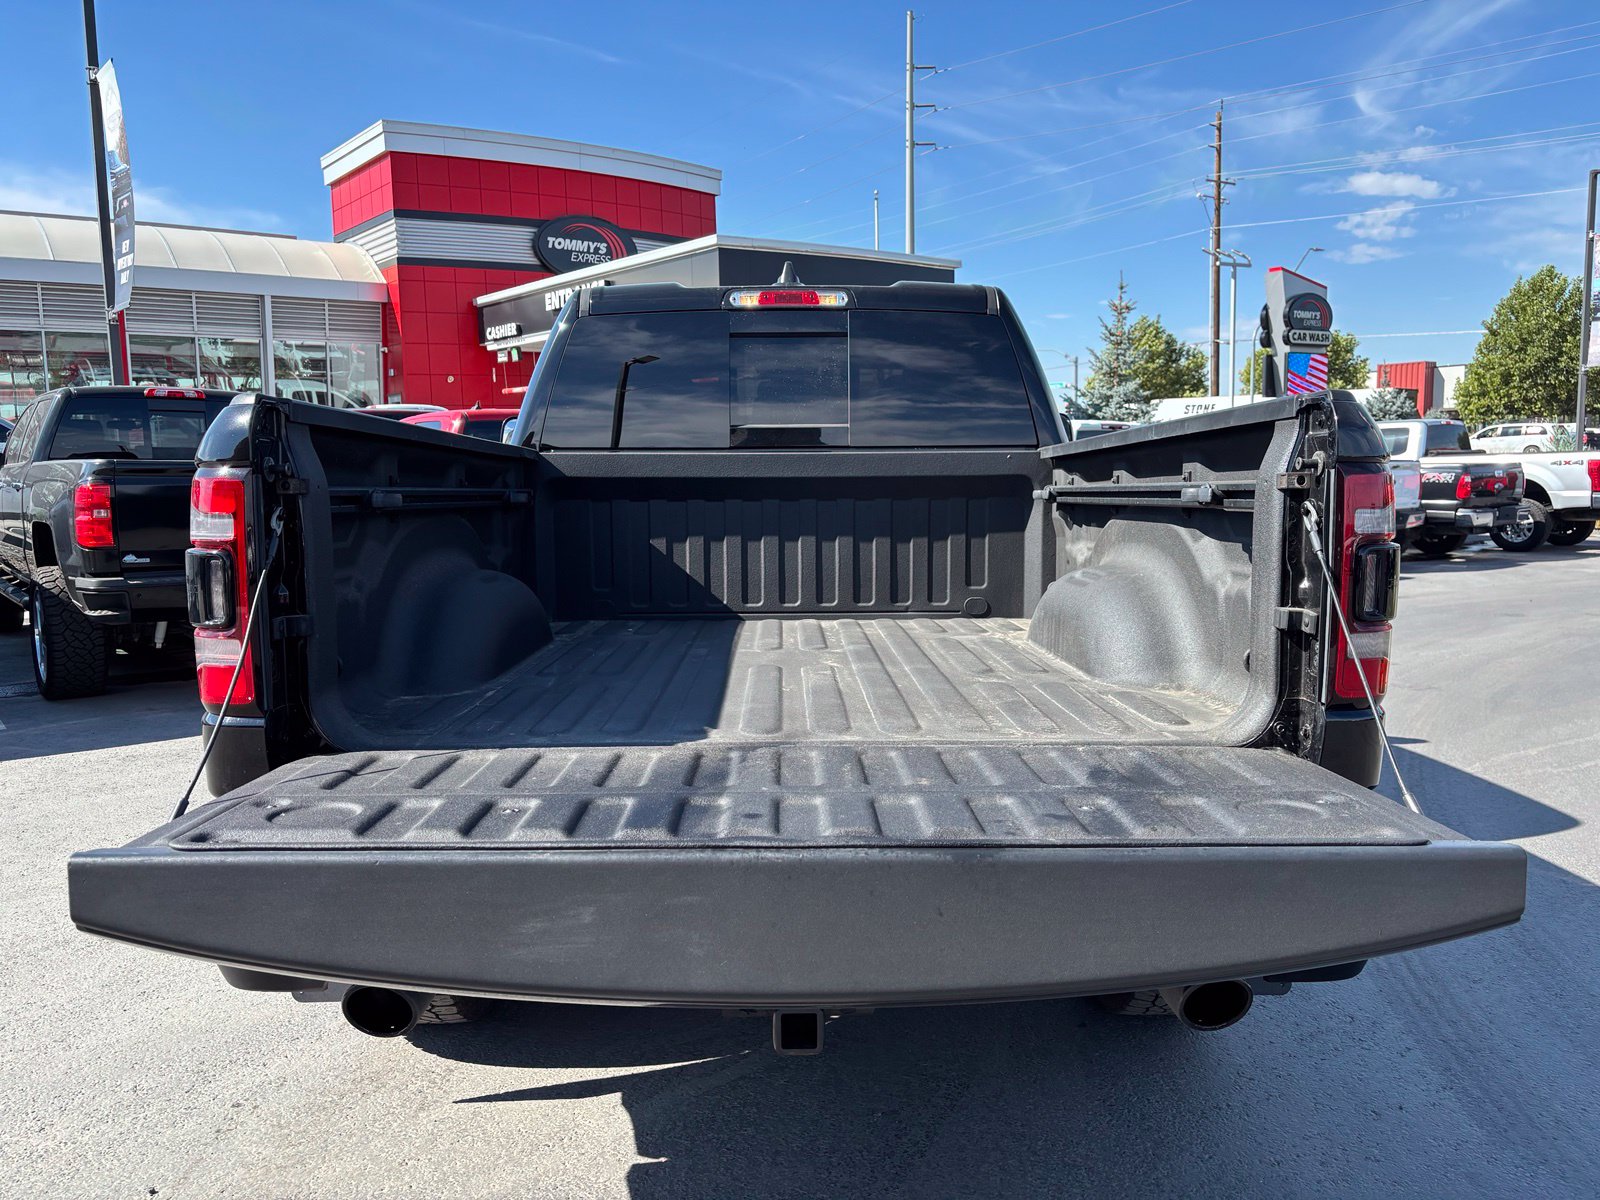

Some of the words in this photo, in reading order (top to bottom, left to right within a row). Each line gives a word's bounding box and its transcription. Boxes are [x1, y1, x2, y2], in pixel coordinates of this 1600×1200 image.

[547, 237, 608, 254] TOMMY'S
[571, 252, 611, 264] EXPRESS
[544, 279, 605, 311] ENTR
[1293, 310, 1321, 319] TOMMY'S
[486, 322, 517, 340] CASHIER
[1292, 332, 1307, 341] CAR
[1309, 333, 1330, 343] WASH
